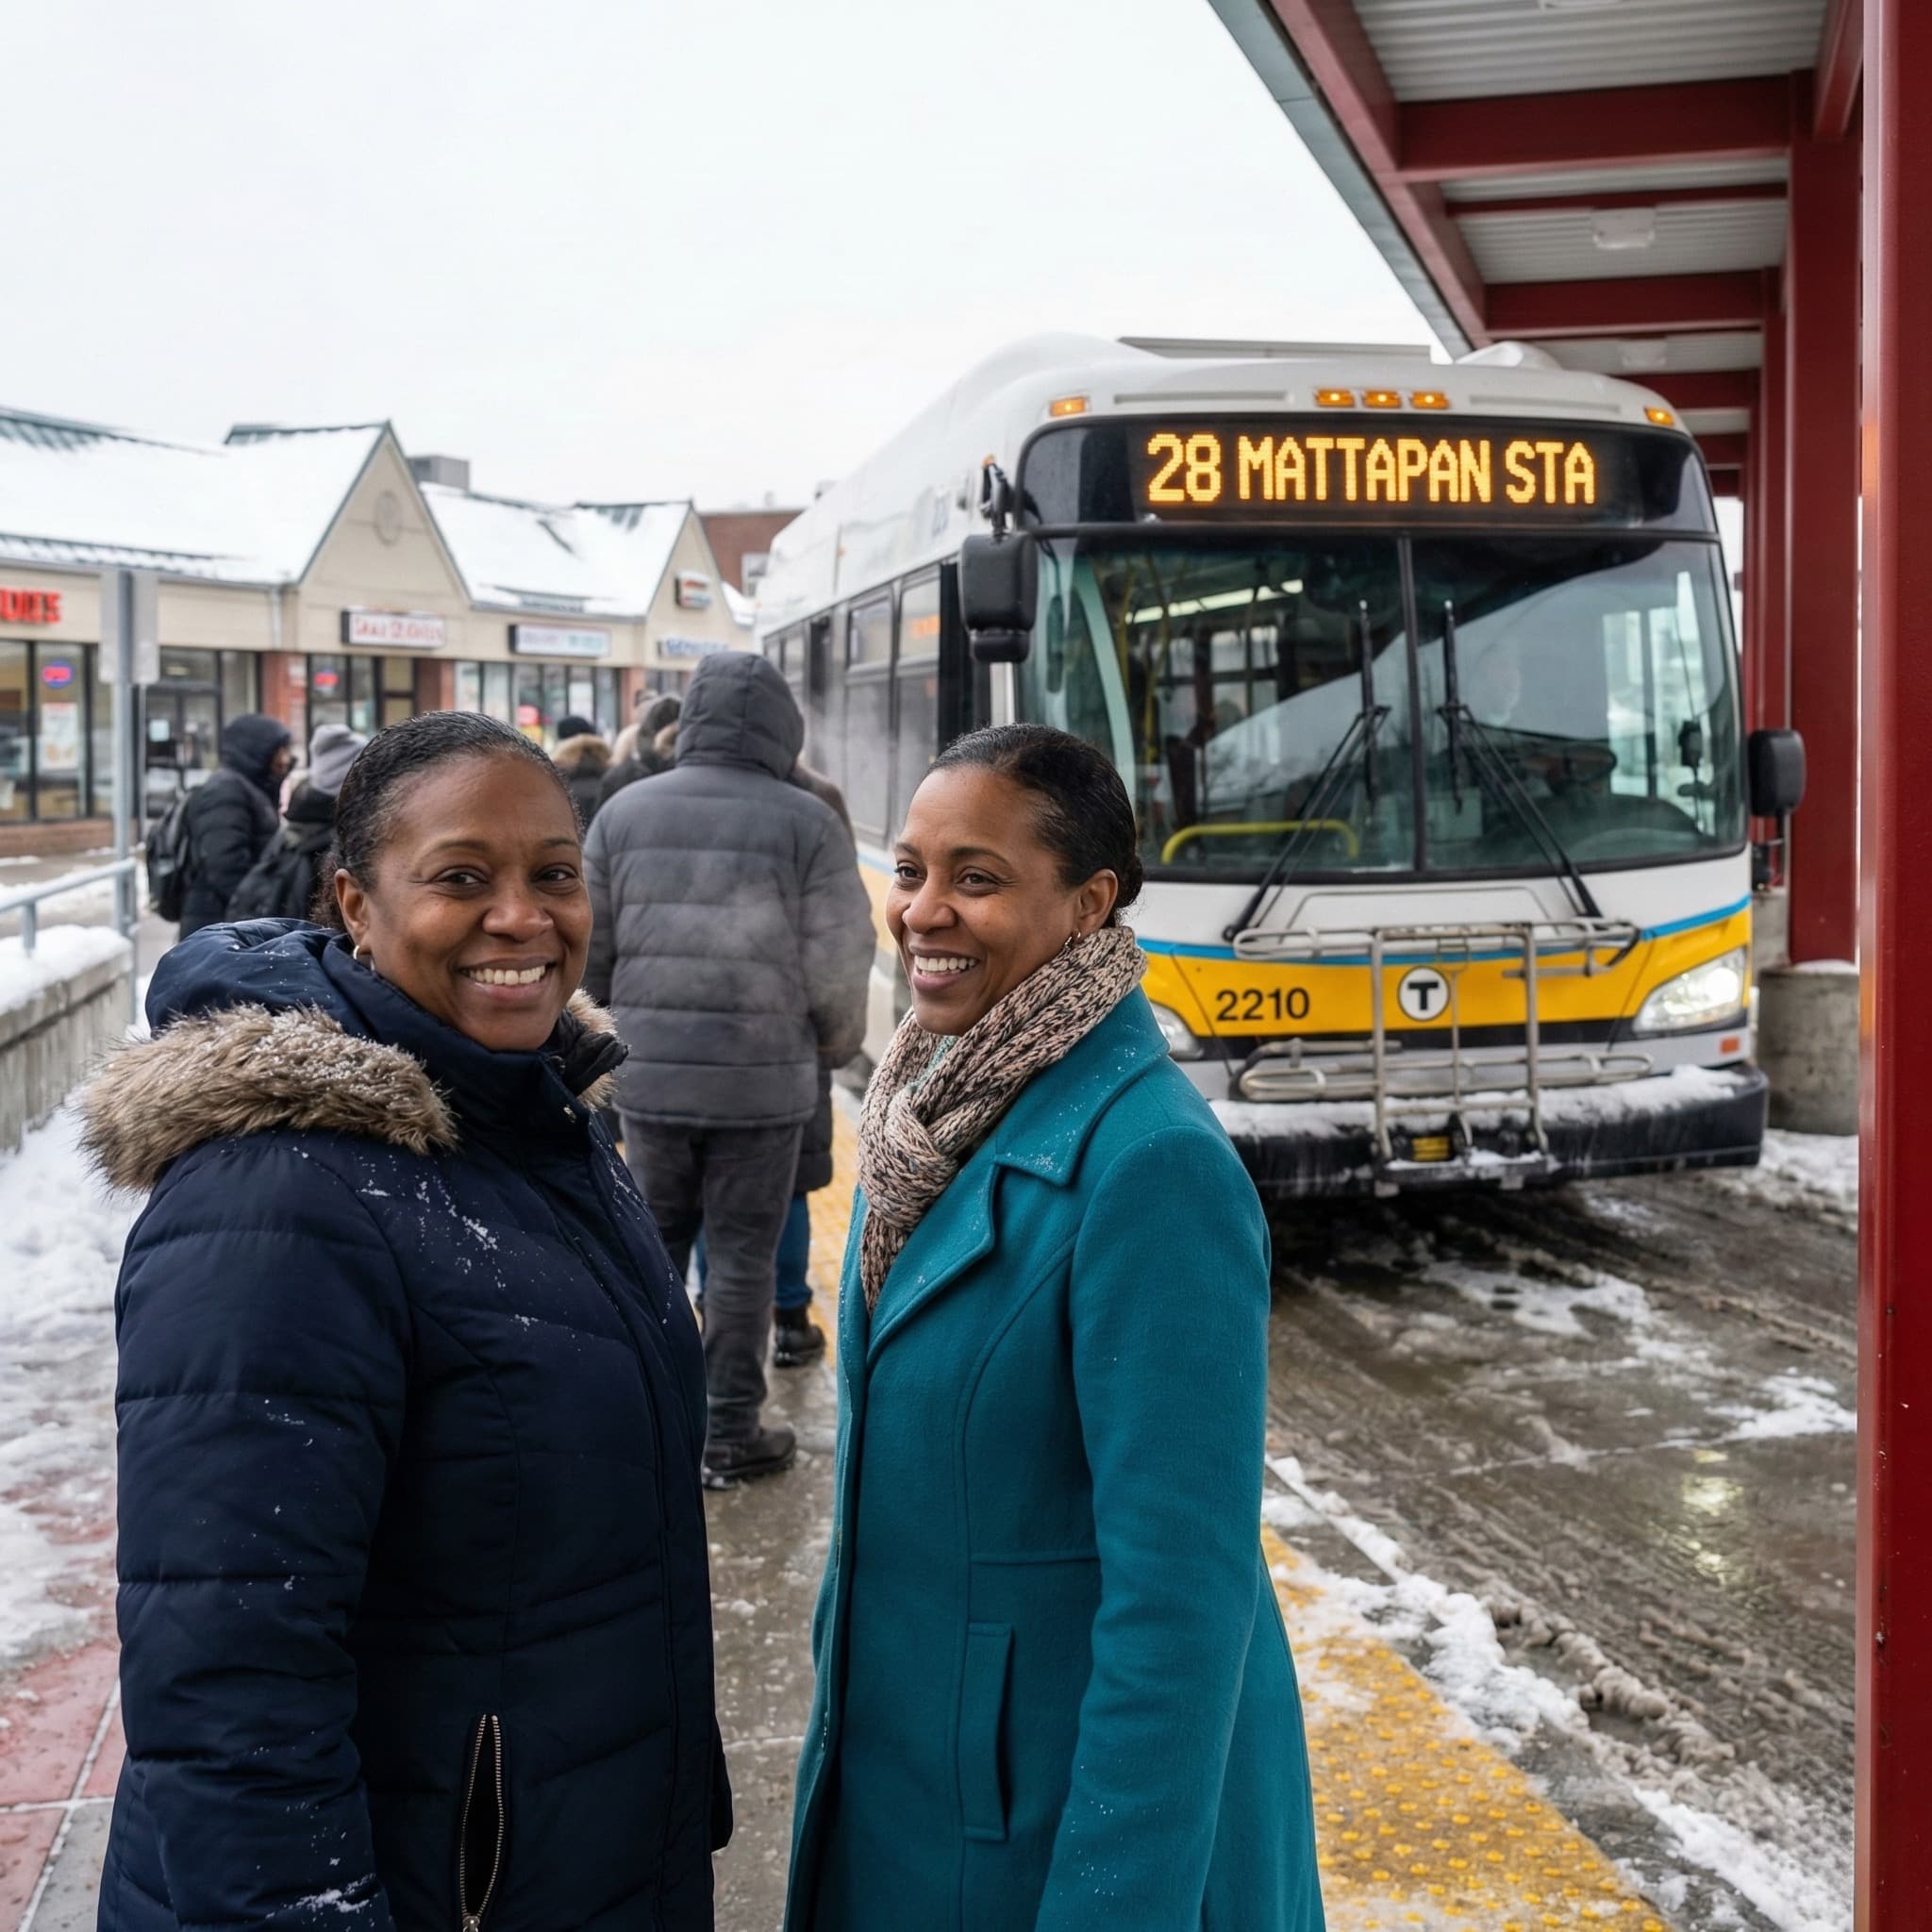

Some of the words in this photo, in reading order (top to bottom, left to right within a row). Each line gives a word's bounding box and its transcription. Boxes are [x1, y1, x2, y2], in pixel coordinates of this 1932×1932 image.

[1146, 433, 1222, 503] 28
[1238, 435, 1491, 503] MATTAPAN
[1505, 440, 1595, 505] STA
[1216, 988, 1309, 1021] 2210
[1407, 981, 1440, 1011] T
